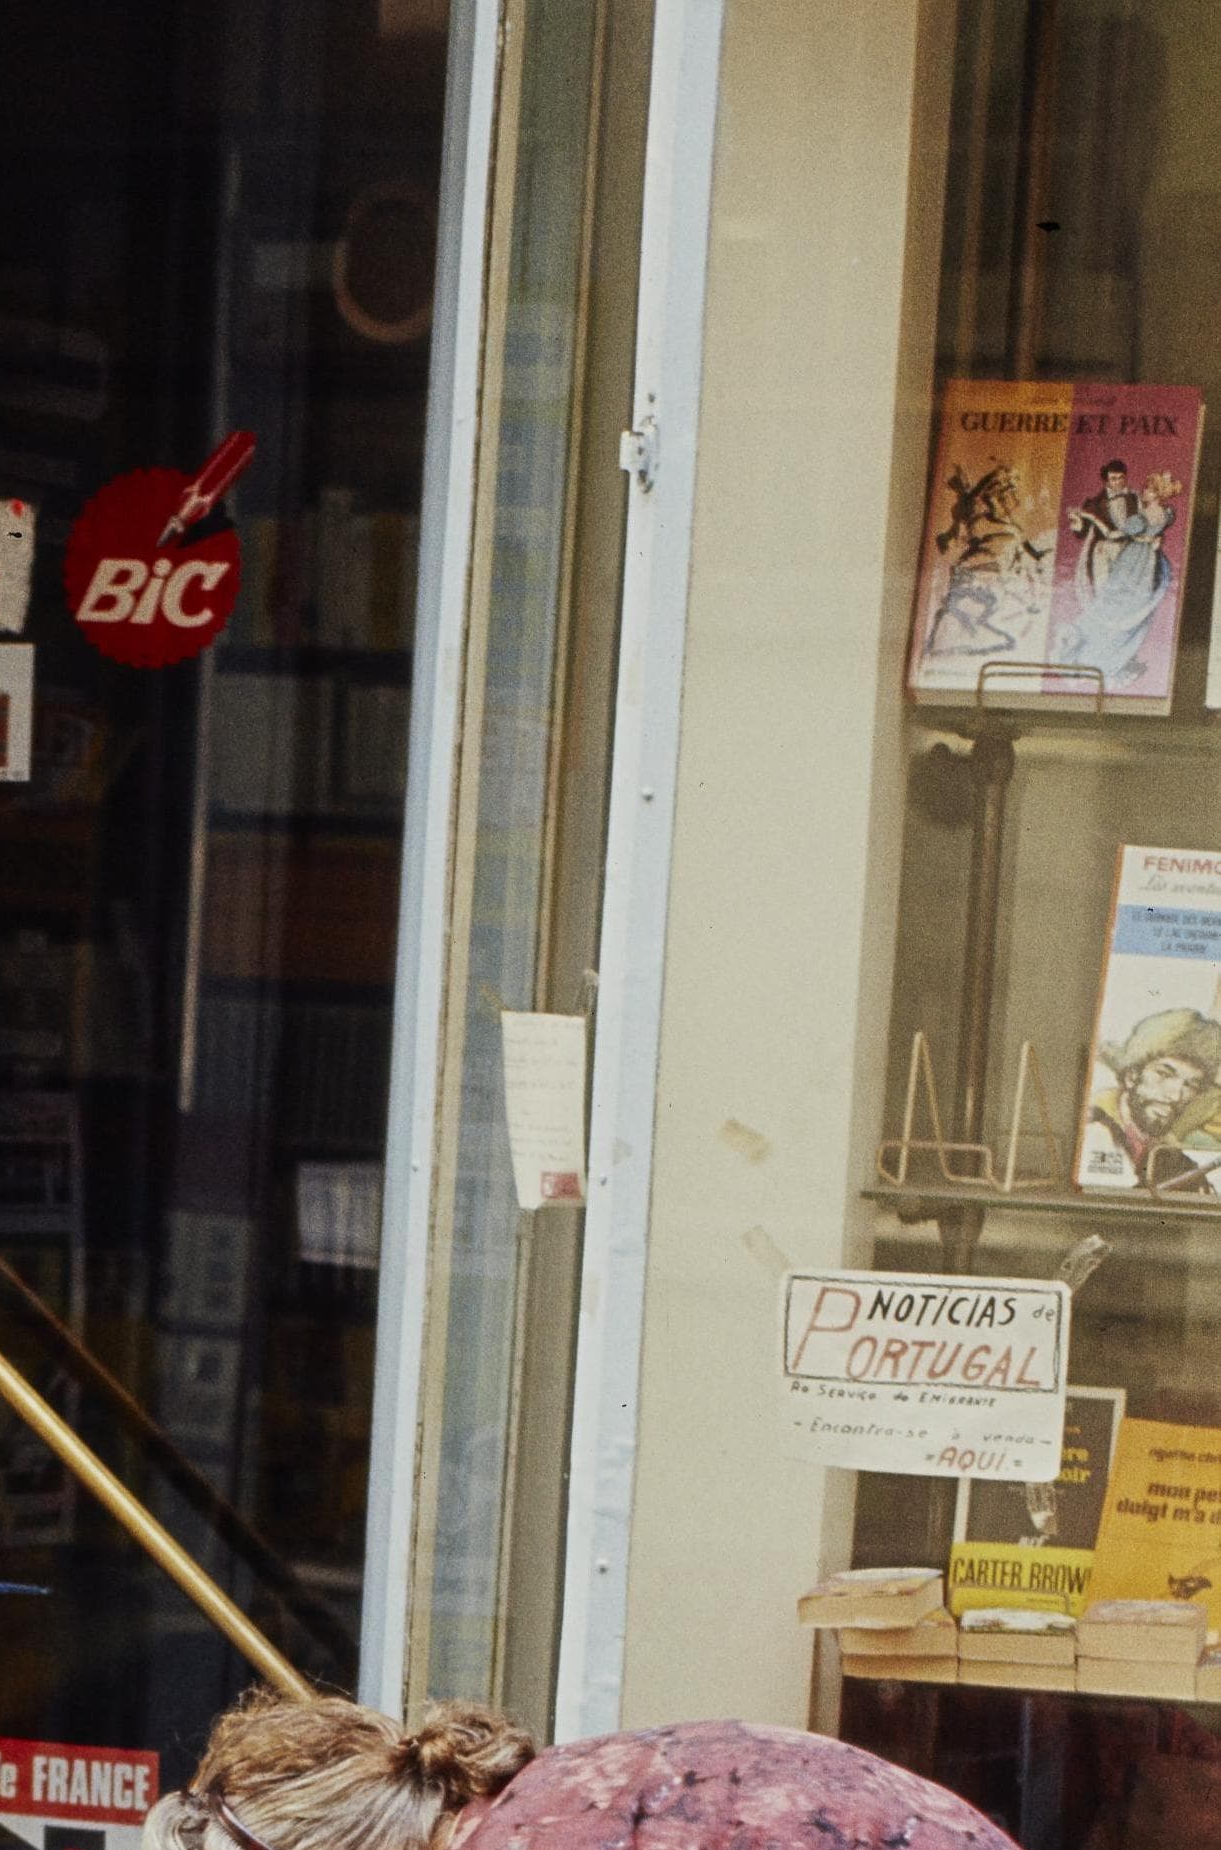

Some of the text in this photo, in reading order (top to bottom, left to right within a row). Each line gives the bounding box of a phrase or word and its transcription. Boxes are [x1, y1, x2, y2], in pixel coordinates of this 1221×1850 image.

[960, 411, 1178, 436] GUERRE ET PAIX
[76, 558, 230, 628] BiC
[1032, 1305, 1057, 1322] de
[791, 1286, 1040, 1388] PORTUGAL
[982, 1432, 1035, 1446] venda
[952, 1557, 1023, 1589] CARTER
[32, 1756, 151, 1812] FRANCE
